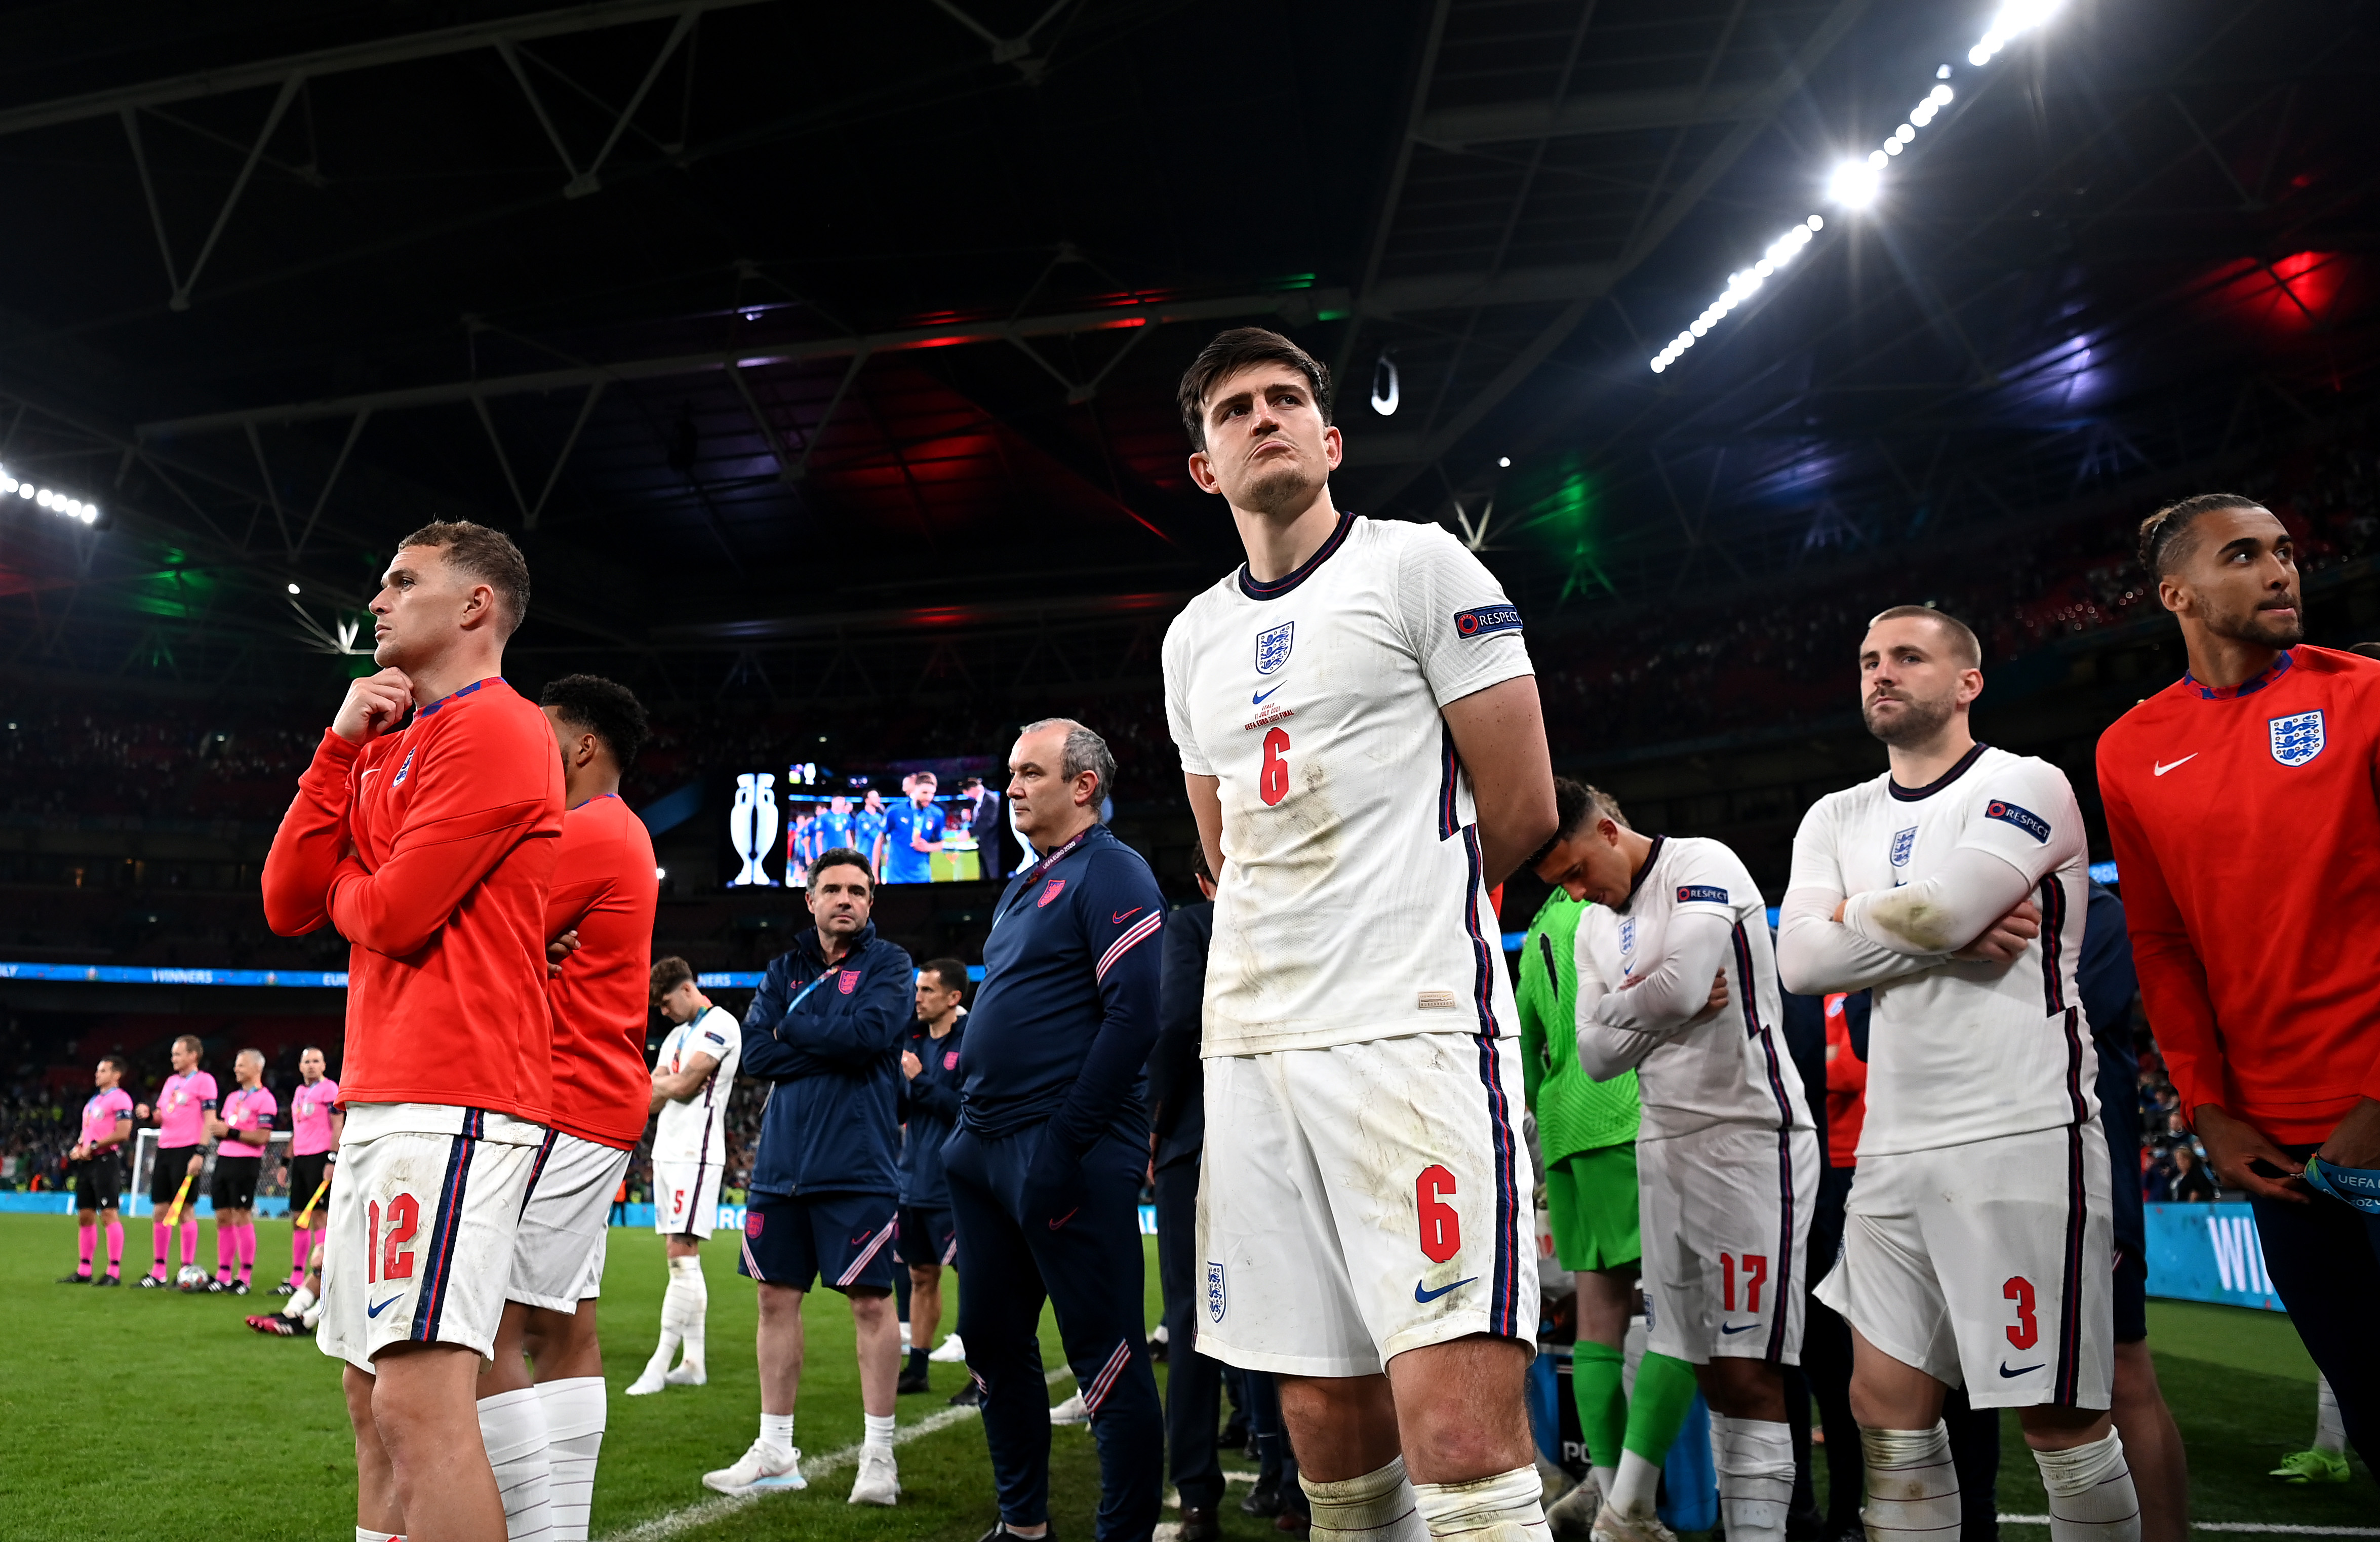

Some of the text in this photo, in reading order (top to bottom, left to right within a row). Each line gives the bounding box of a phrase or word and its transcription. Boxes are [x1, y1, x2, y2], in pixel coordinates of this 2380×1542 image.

[1479, 611, 1519, 626] RESPECT
[1244, 709, 1294, 731] UEFA EURO 2020 FINAL
[1259, 709, 1270, 718] JULY
[1271, 706, 1280, 714] 2021
[1260, 727, 1290, 806] 6
[2005, 809, 2049, 838] RESPECT
[1042, 841, 1076, 869] UEFA EURO 2020
[1691, 889, 1727, 901] RESPECT
[151, 969, 213, 983] WINNERS
[2338, 1174, 2375, 1189] UEFA
[675, 1190, 685, 1214] 5
[1416, 1164, 1461, 1263] 6
[368, 1193, 420, 1284] 12
[1721, 1252, 1767, 1314] 17
[2003, 1276, 2038, 1351] 3
